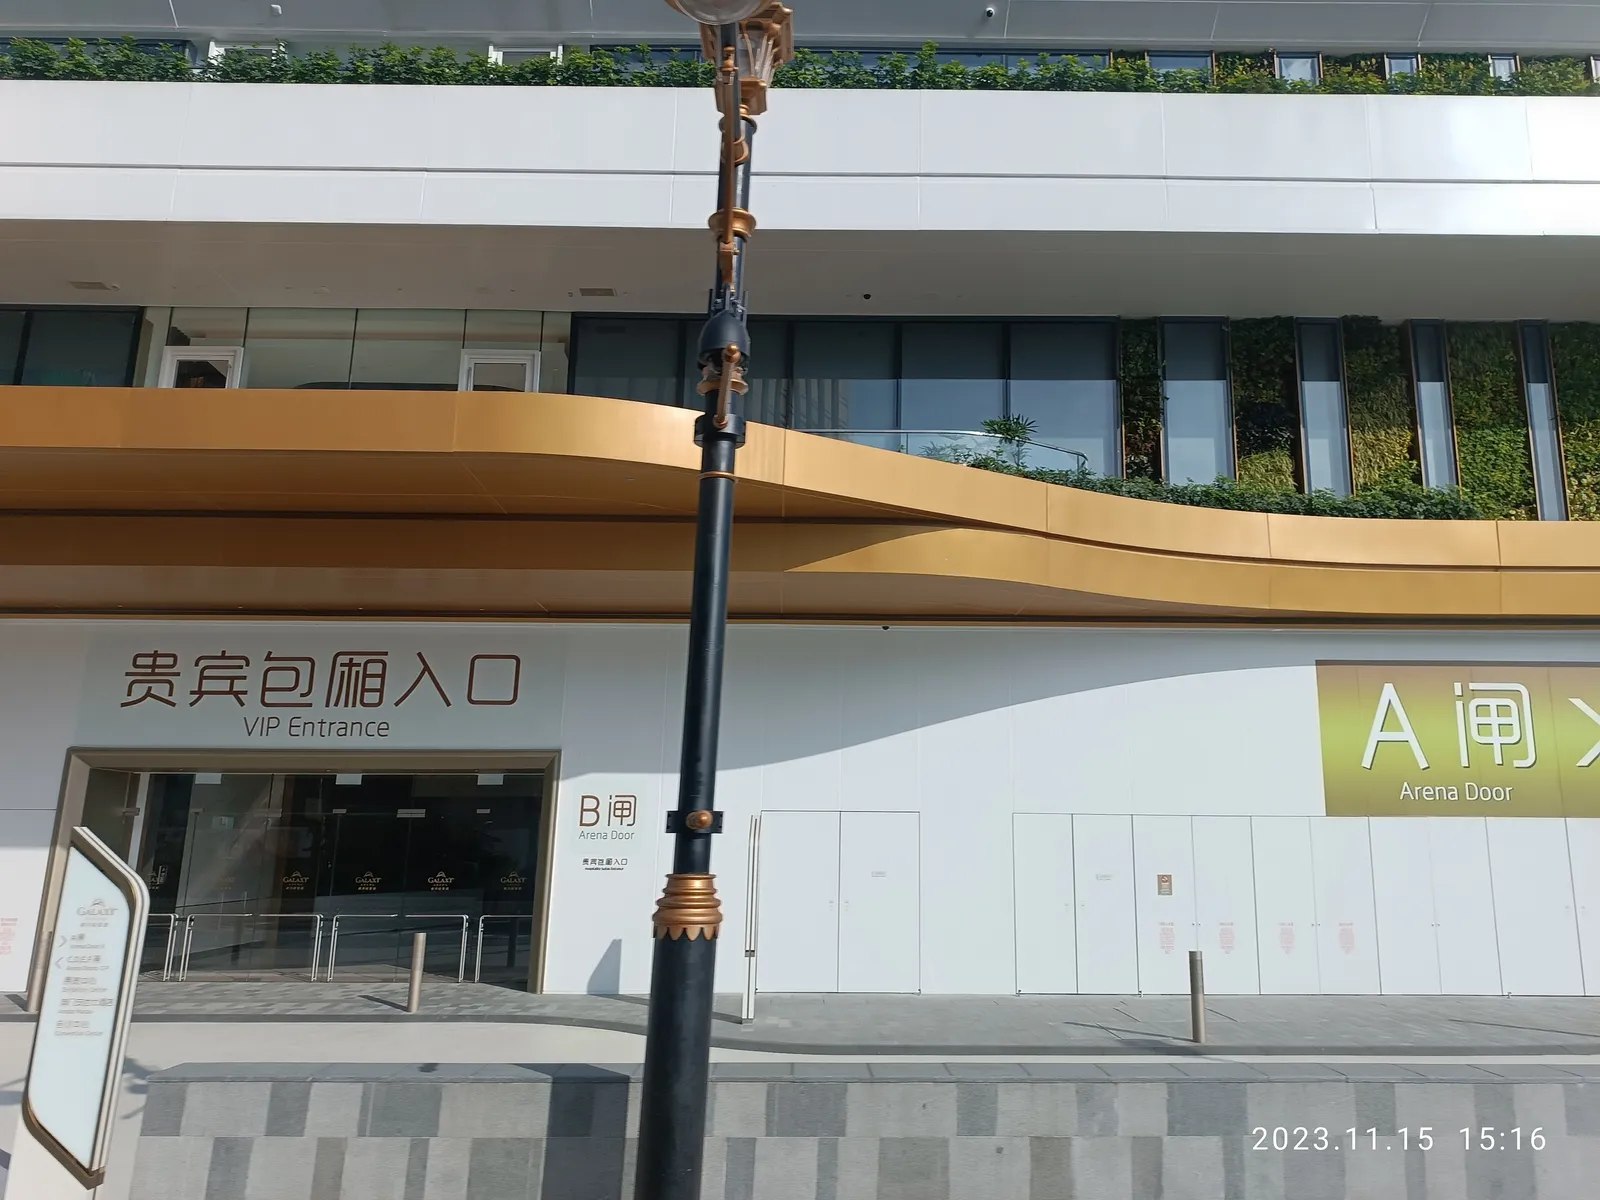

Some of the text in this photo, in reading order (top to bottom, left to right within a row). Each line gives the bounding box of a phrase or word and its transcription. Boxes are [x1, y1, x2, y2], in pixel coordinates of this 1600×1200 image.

[120, 649, 521, 708] 贵宾包厢入口
[243, 716, 390, 738] VIP Entrance
[1400, 781, 1513, 801] Arena Door
[578, 830, 635, 840] Arena Door
